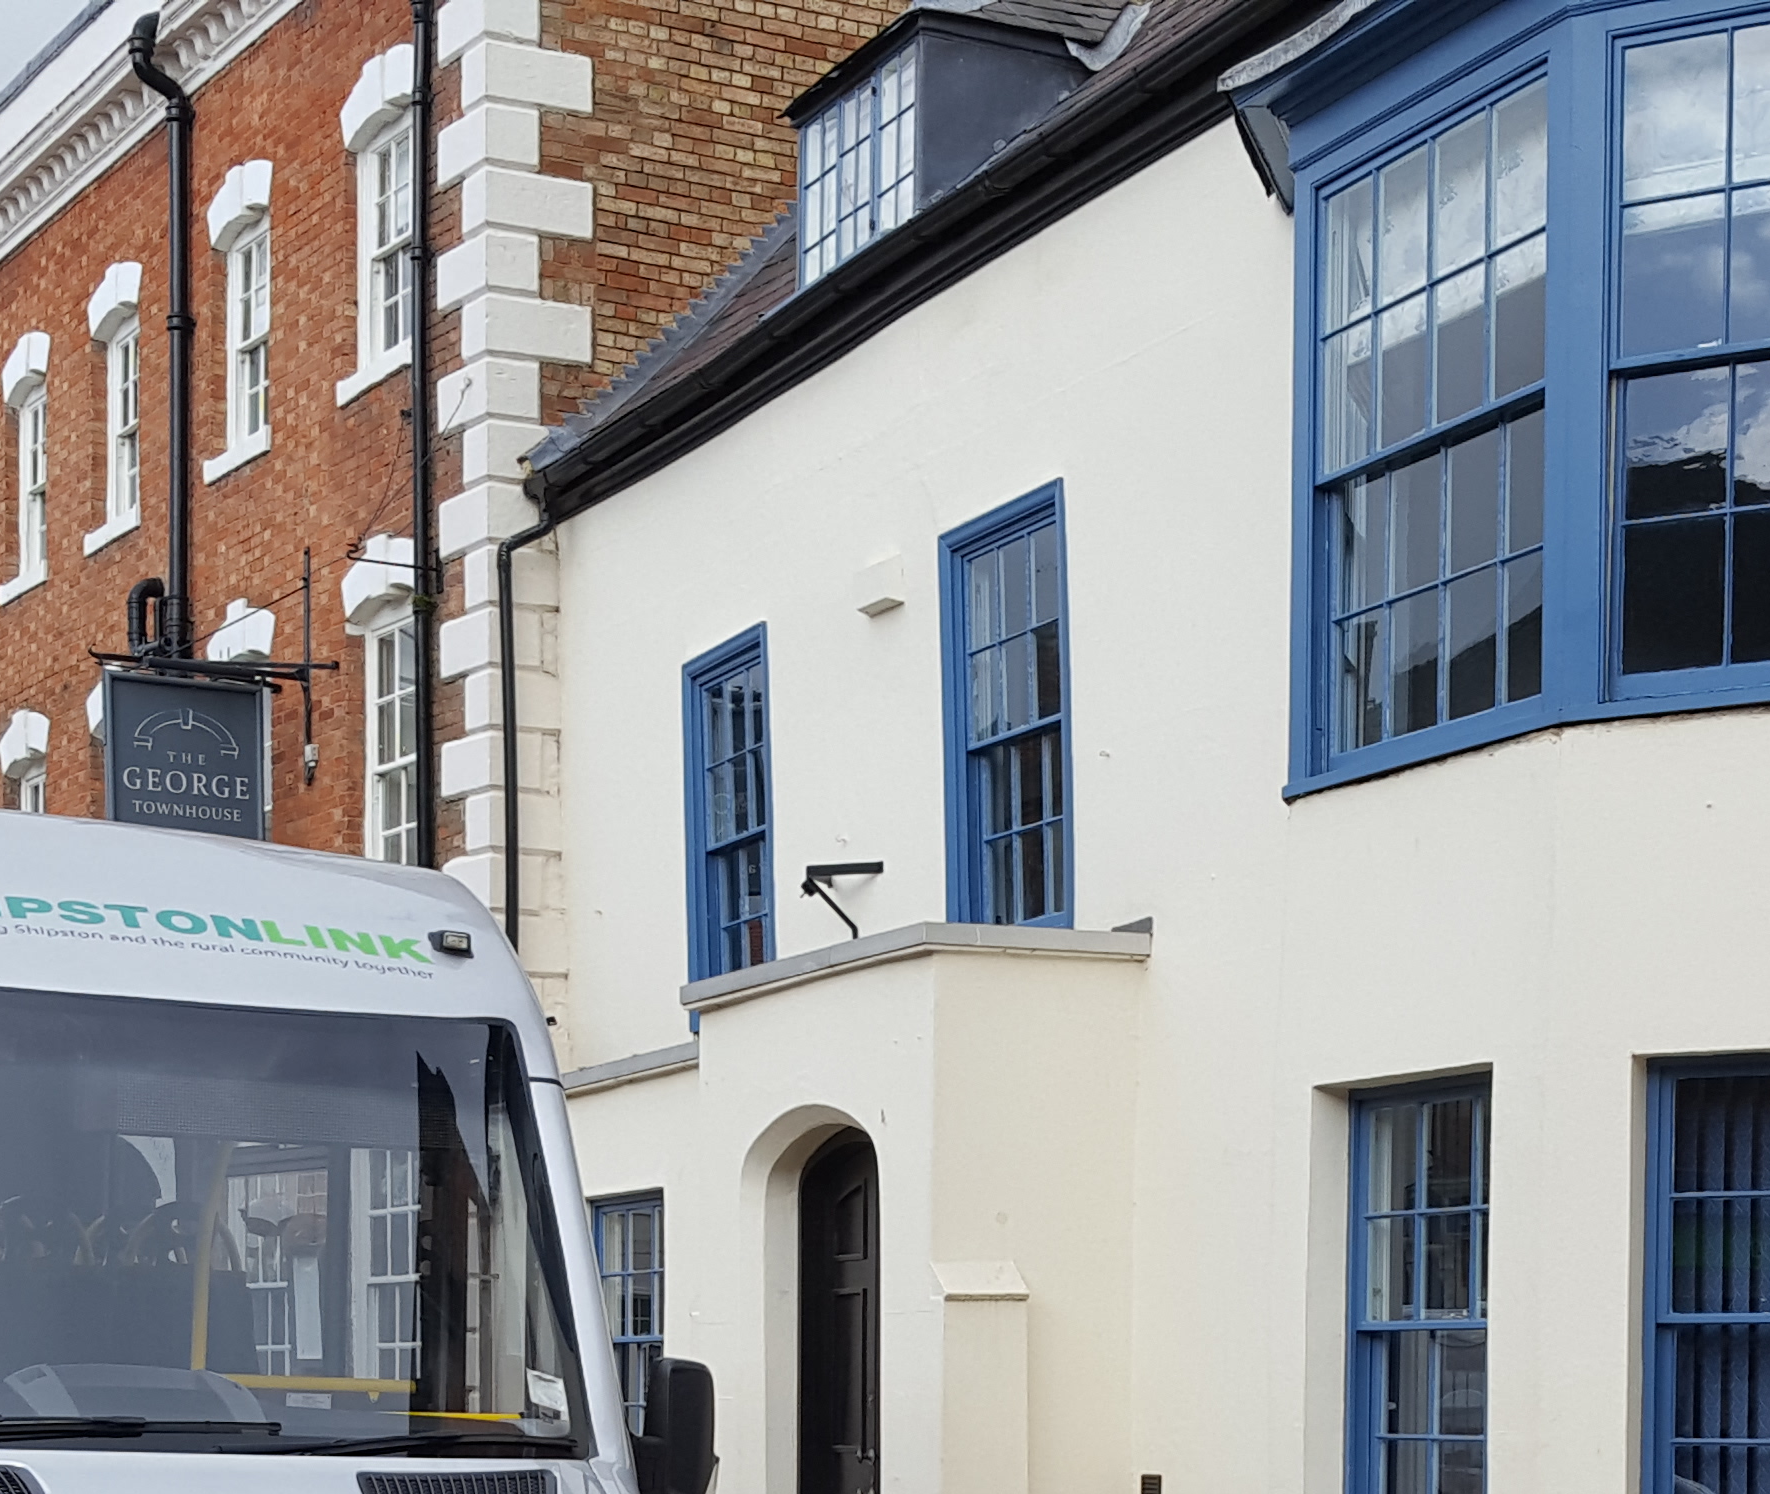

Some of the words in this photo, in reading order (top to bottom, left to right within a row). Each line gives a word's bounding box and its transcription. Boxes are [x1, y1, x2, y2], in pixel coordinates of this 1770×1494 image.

[166, 750, 207, 766] THE
[122, 766, 250, 800] GEORGE
[131, 799, 243, 822] TOWNHOUSE
[14, 924, 104, 942] Shipston
[109, 932, 147, 946] and
[150, 936, 185, 950] the
[190, 942, 236, 954] rural
[240, 946, 350, 969] community
[353, 959, 435, 980] together
